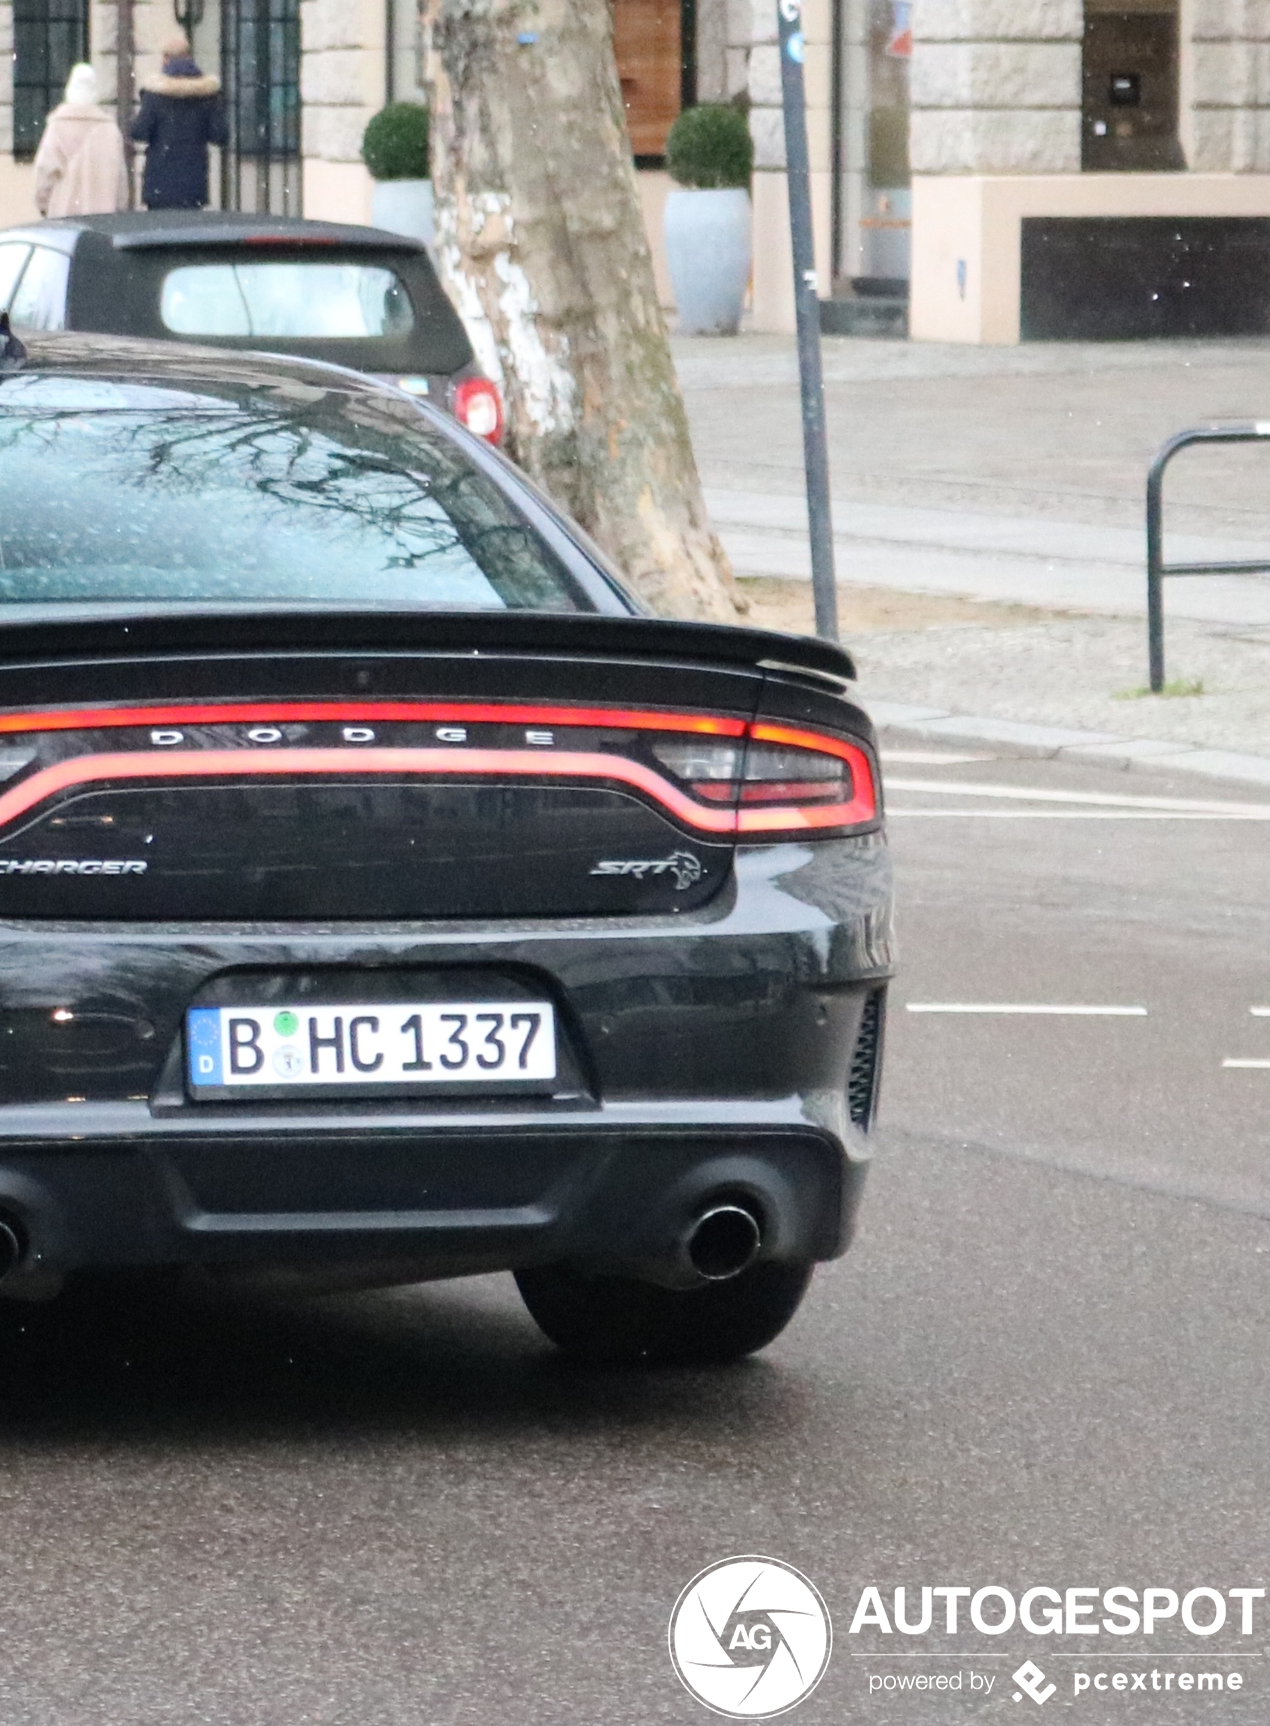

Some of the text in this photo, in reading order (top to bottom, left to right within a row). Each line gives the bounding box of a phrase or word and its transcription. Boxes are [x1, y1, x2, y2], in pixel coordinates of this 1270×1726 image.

[151, 727, 554, 745] DODGE
[590, 861, 678, 879] SRT
[229, 1013, 542, 1075] B HC 1337
[199, 1055, 214, 1073] D
